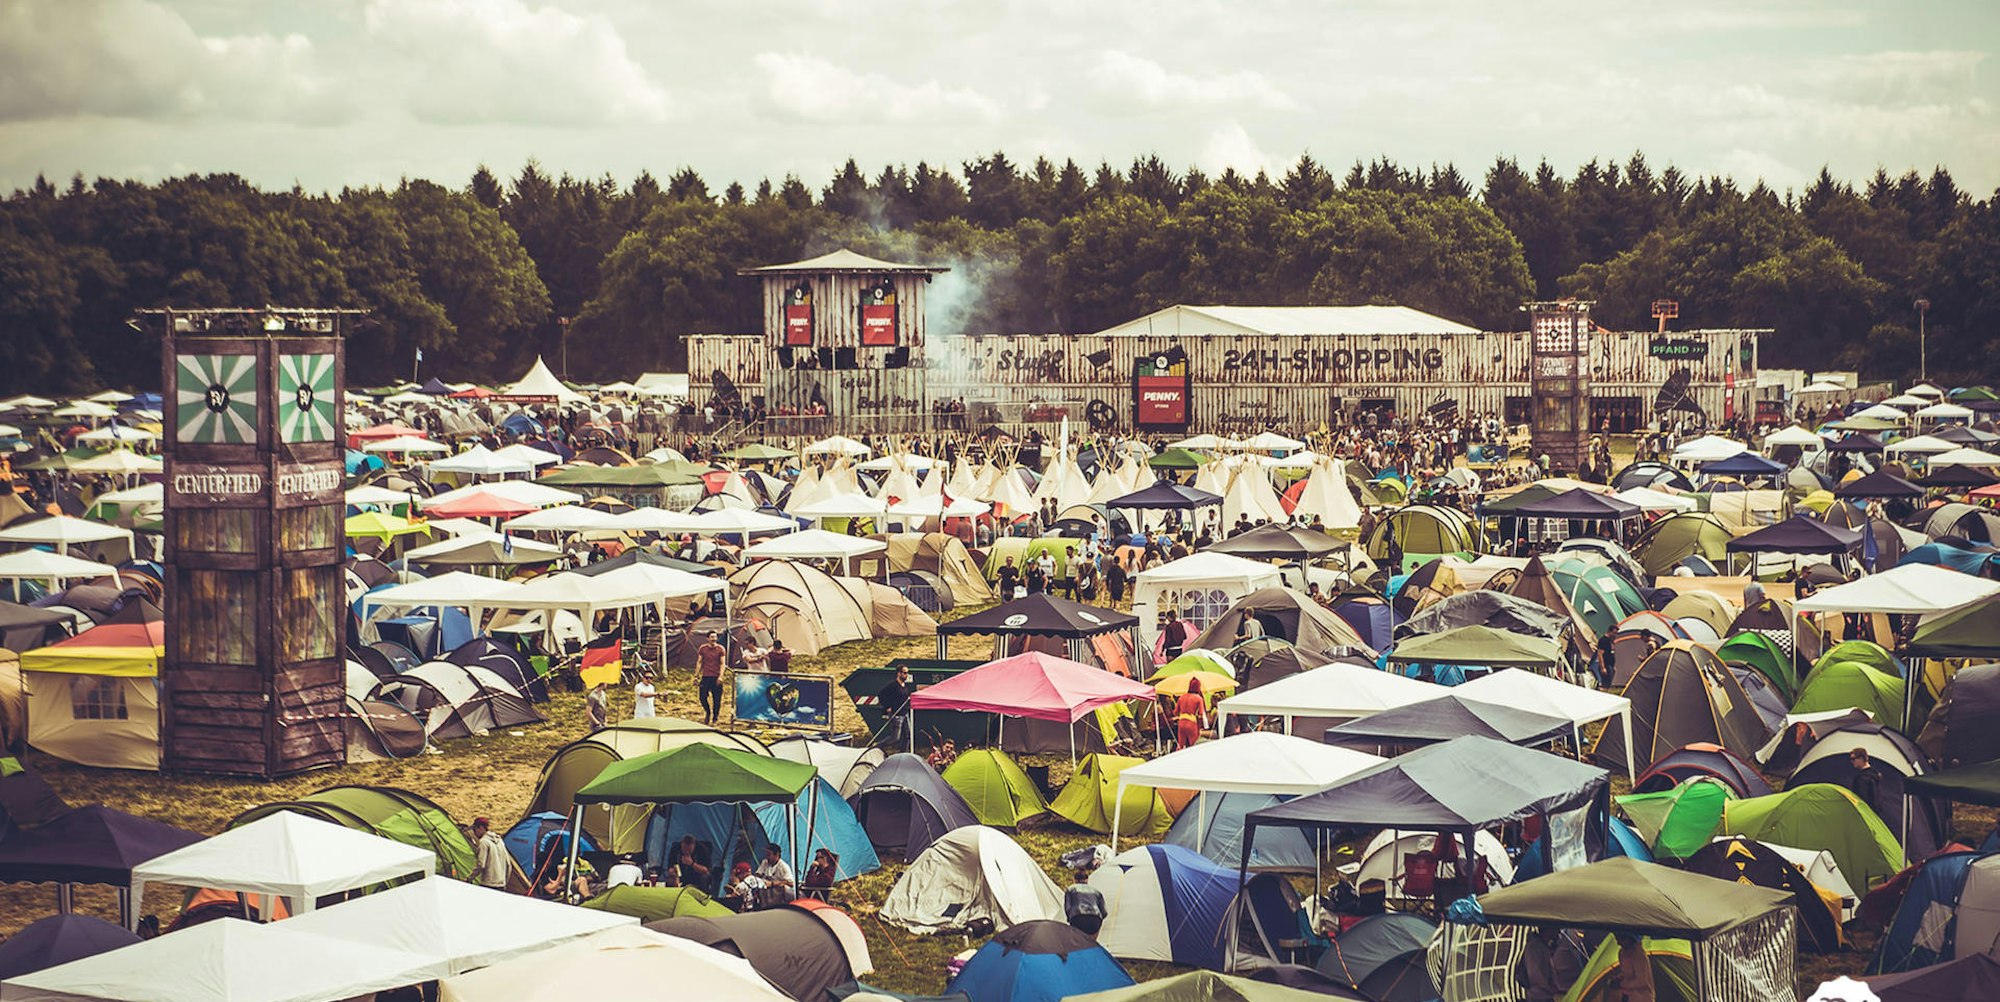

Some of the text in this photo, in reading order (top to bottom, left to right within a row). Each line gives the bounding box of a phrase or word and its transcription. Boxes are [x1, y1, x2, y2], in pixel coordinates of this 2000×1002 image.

[1224, 349, 1443, 371] 24H-SHOPPING
[1652, 346, 1690, 354] PFAND
[996, 349, 1064, 378] Stuff
[1143, 391, 1181, 402] PENNY.
[174, 473, 262, 495] CENTERFIELD
[279, 469, 341, 496] CENTERFIELD
